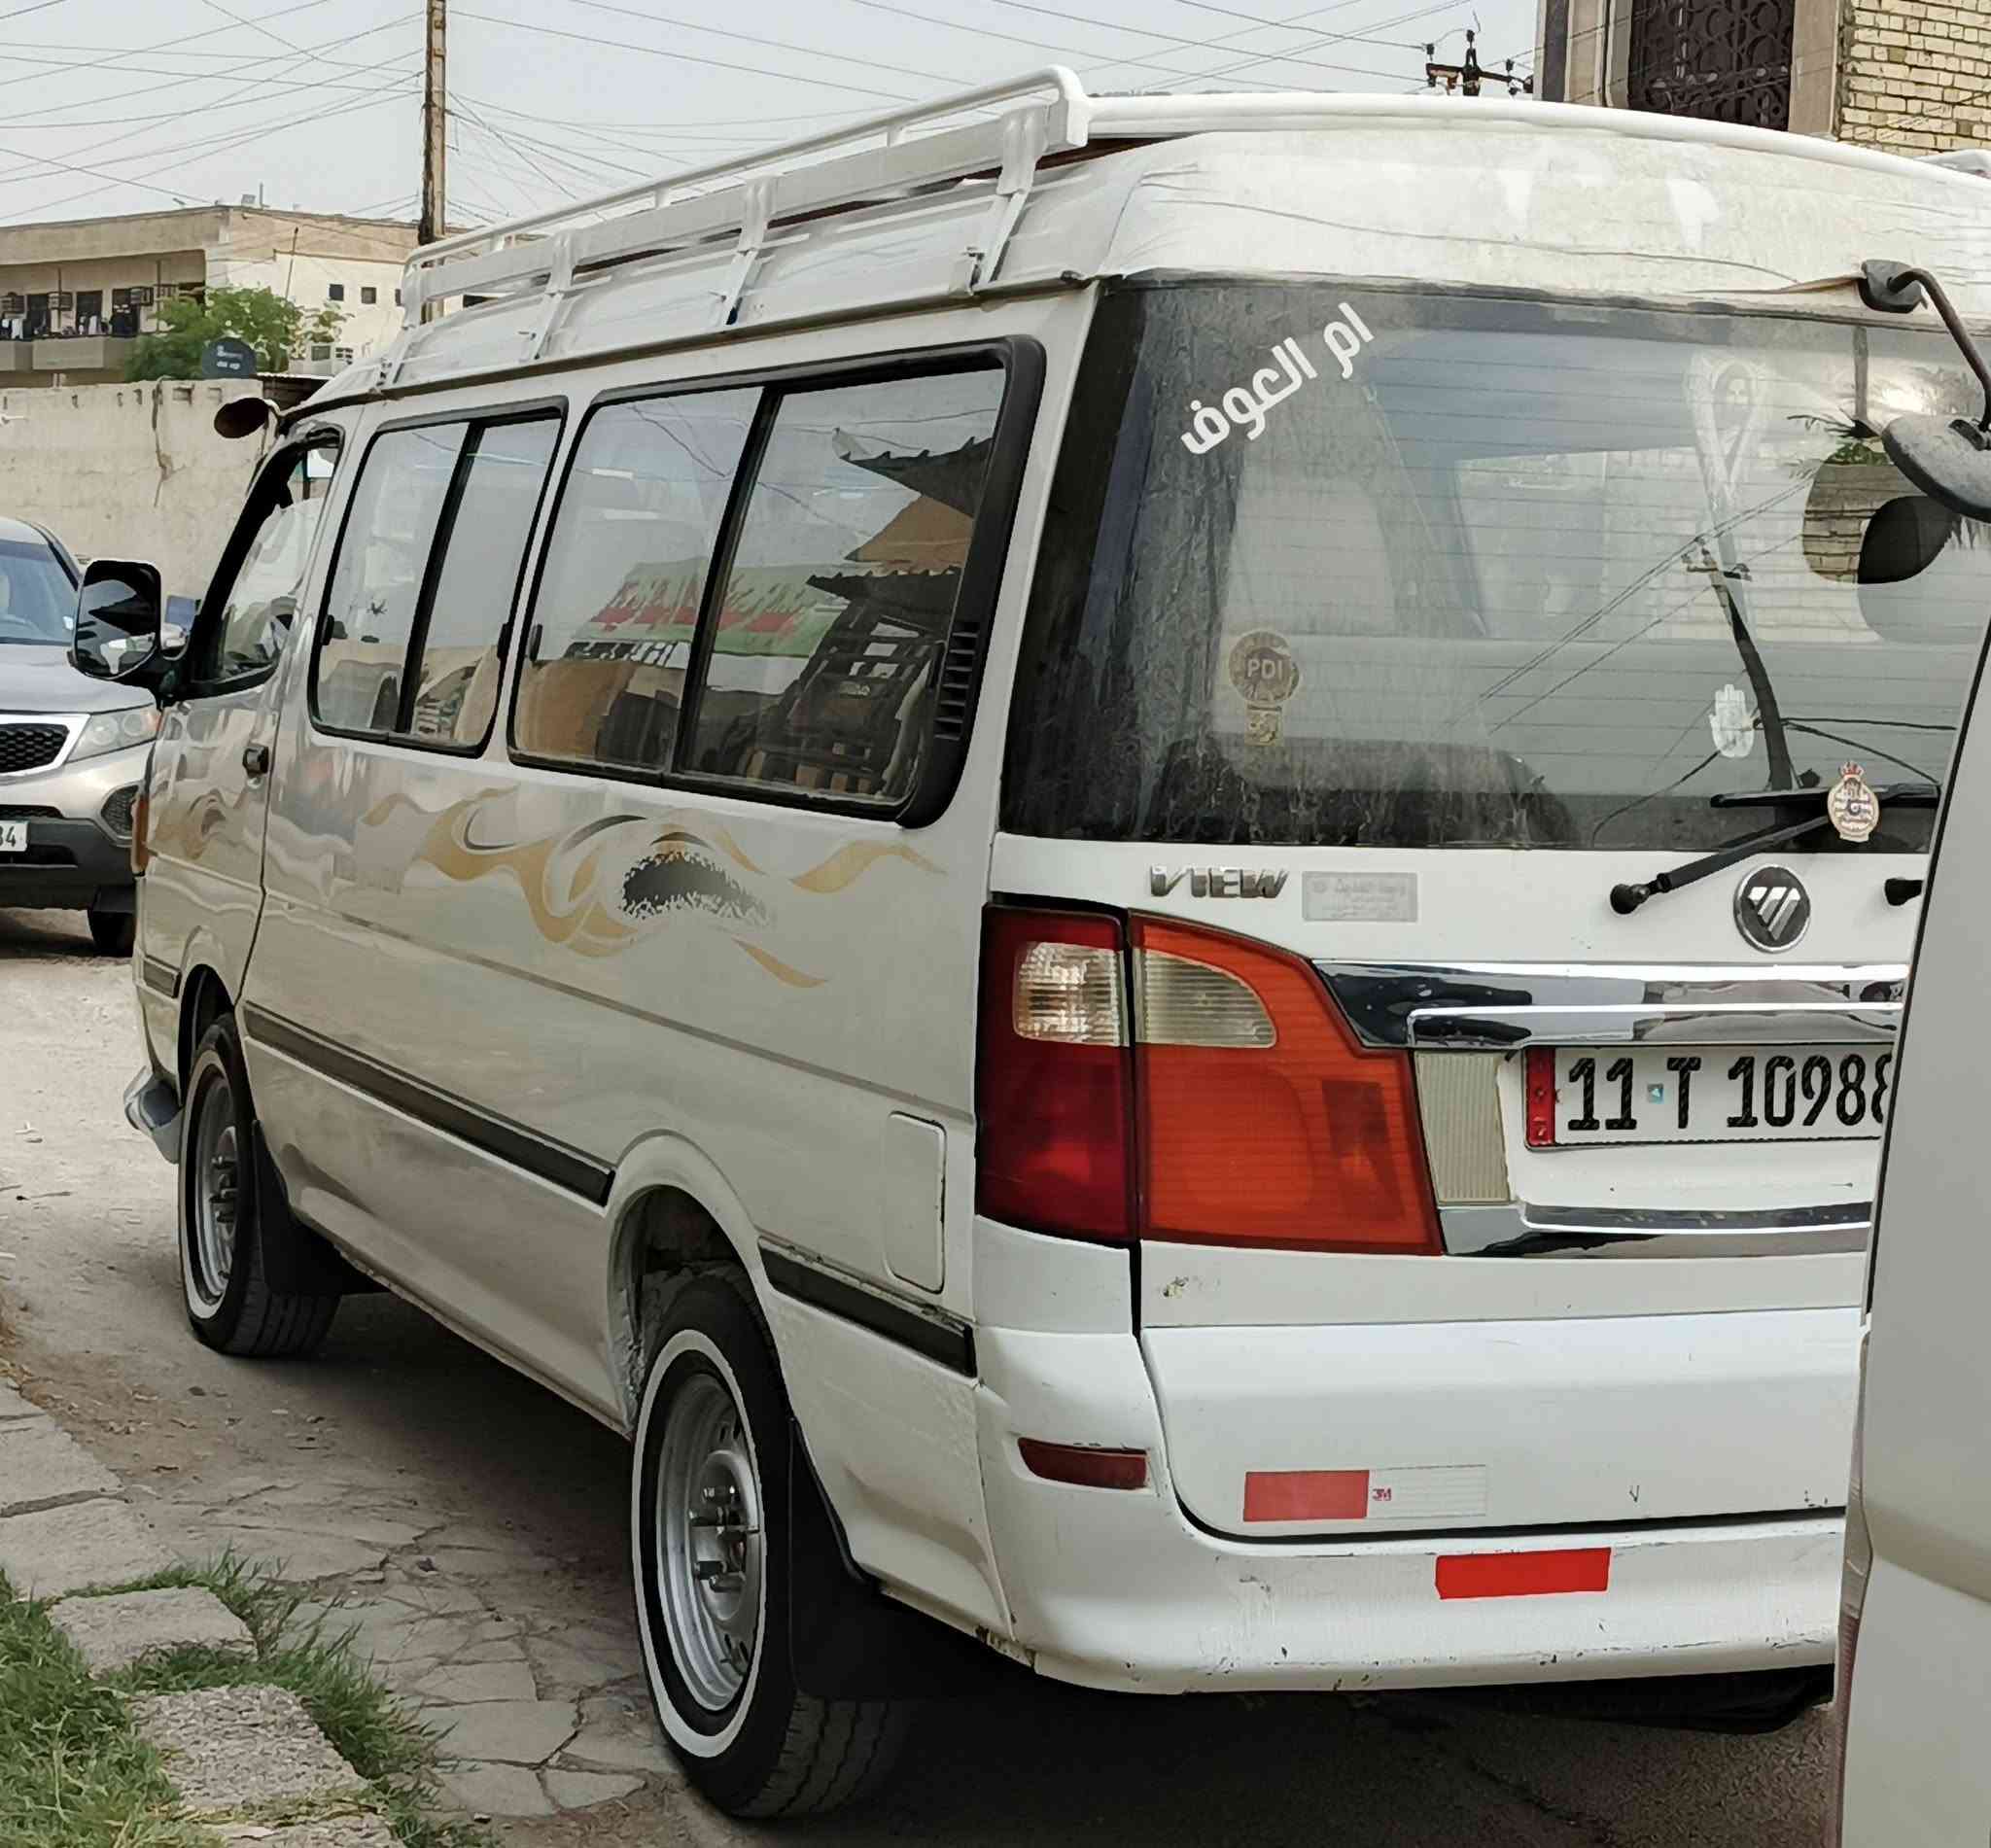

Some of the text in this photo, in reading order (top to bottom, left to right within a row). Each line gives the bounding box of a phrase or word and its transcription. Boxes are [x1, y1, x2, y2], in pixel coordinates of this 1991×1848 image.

[1179, 336, 1318, 455] العوف
[1247, 658, 1283, 680] PDI
[1150, 863, 1290, 899] VIEW
[1567, 1057, 1637, 1131] 11
[1666, 1057, 1701, 1130] T
